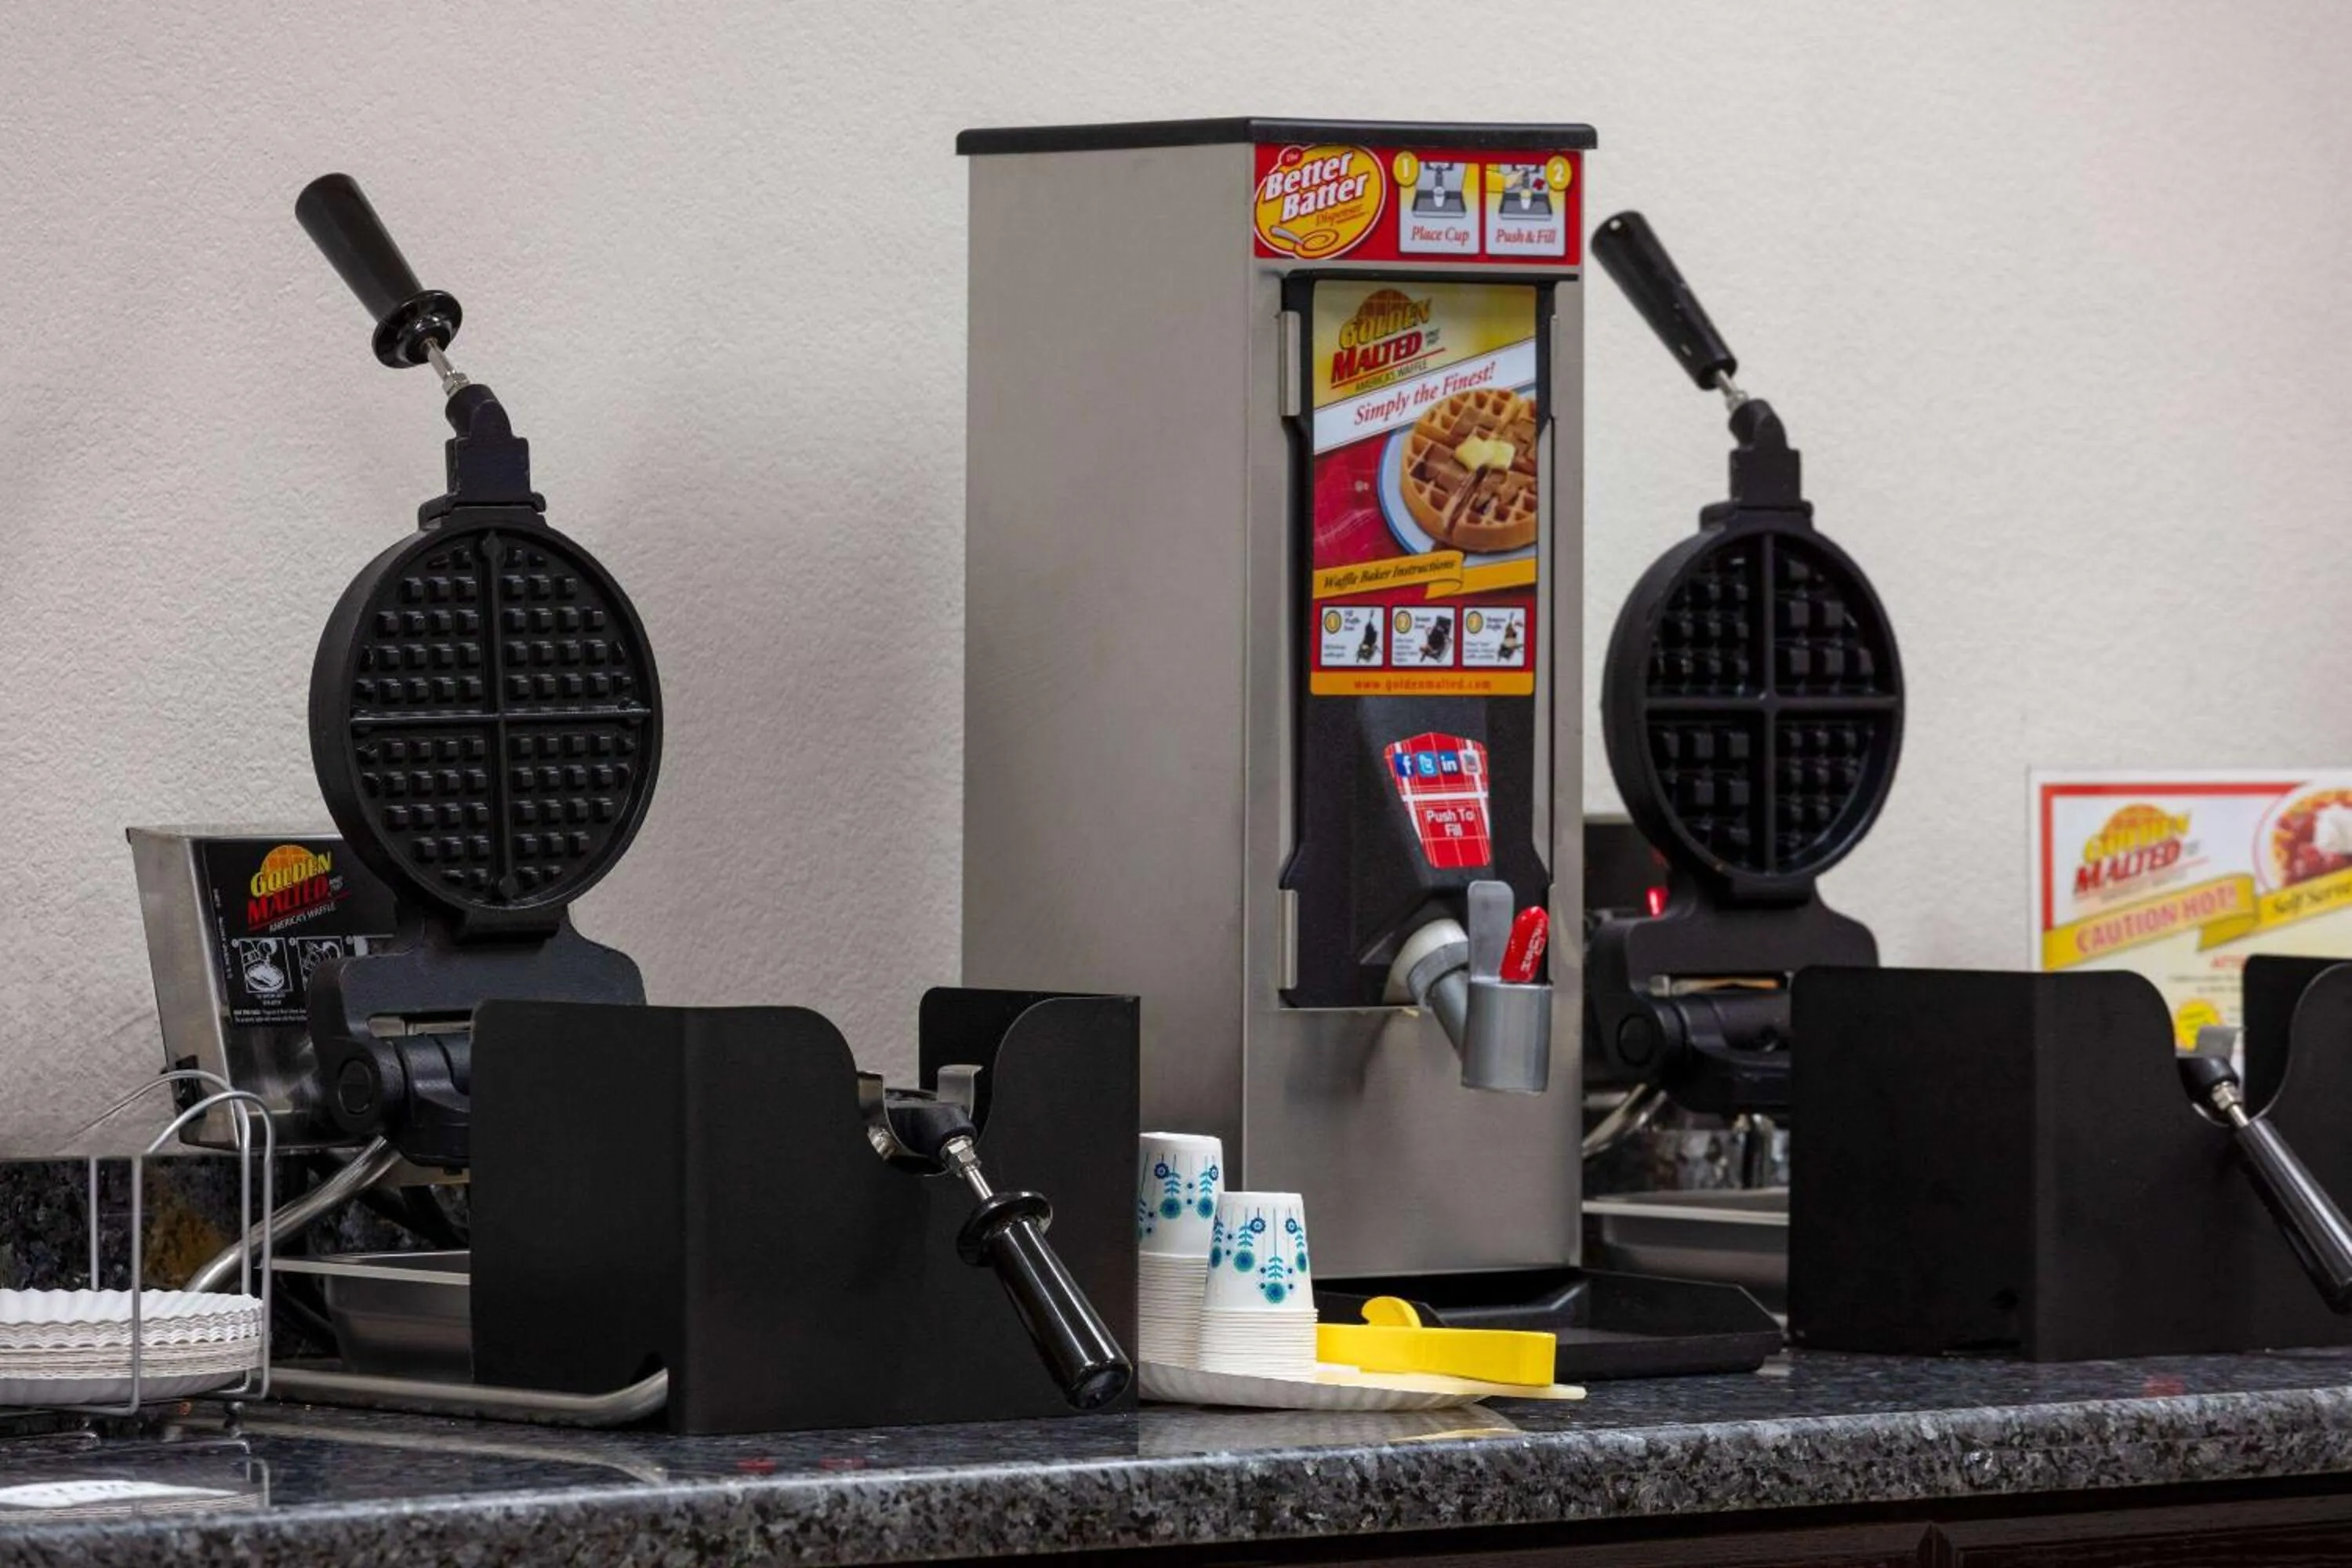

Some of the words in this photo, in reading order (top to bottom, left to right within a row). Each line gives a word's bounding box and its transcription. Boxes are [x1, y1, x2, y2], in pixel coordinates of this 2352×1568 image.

[1264, 151, 1354, 203] Better
[1403, 158, 1409, 178] 1
[1554, 163, 1563, 183] 2
[1280, 172, 1369, 223] Batter
[1410, 226, 1443, 241] Place
[1444, 227, 1470, 246] Cup
[1495, 228, 1523, 243] Push
[1534, 229, 1557, 245] Fill
[1331, 330, 1423, 383] MALTED
[1354, 393, 1410, 425] Simply
[1413, 383, 1439, 405] the
[1442, 361, 1496, 396] Finest!
[1323, 571, 1359, 590] Waffle
[1360, 568, 1392, 584] Baker
[1392, 558, 1456, 578] Instructions
[1426, 808, 1457, 823] Push
[1457, 808, 1475, 822] To
[1444, 822, 1464, 837] Fill
[250, 851, 332, 898] GOLDEN
[2072, 837, 2181, 898] MALTED
[248, 873, 330, 927] MALTED
[307, 902, 336, 920] WAFFLE
[2075, 903, 2178, 954] CAUTION
